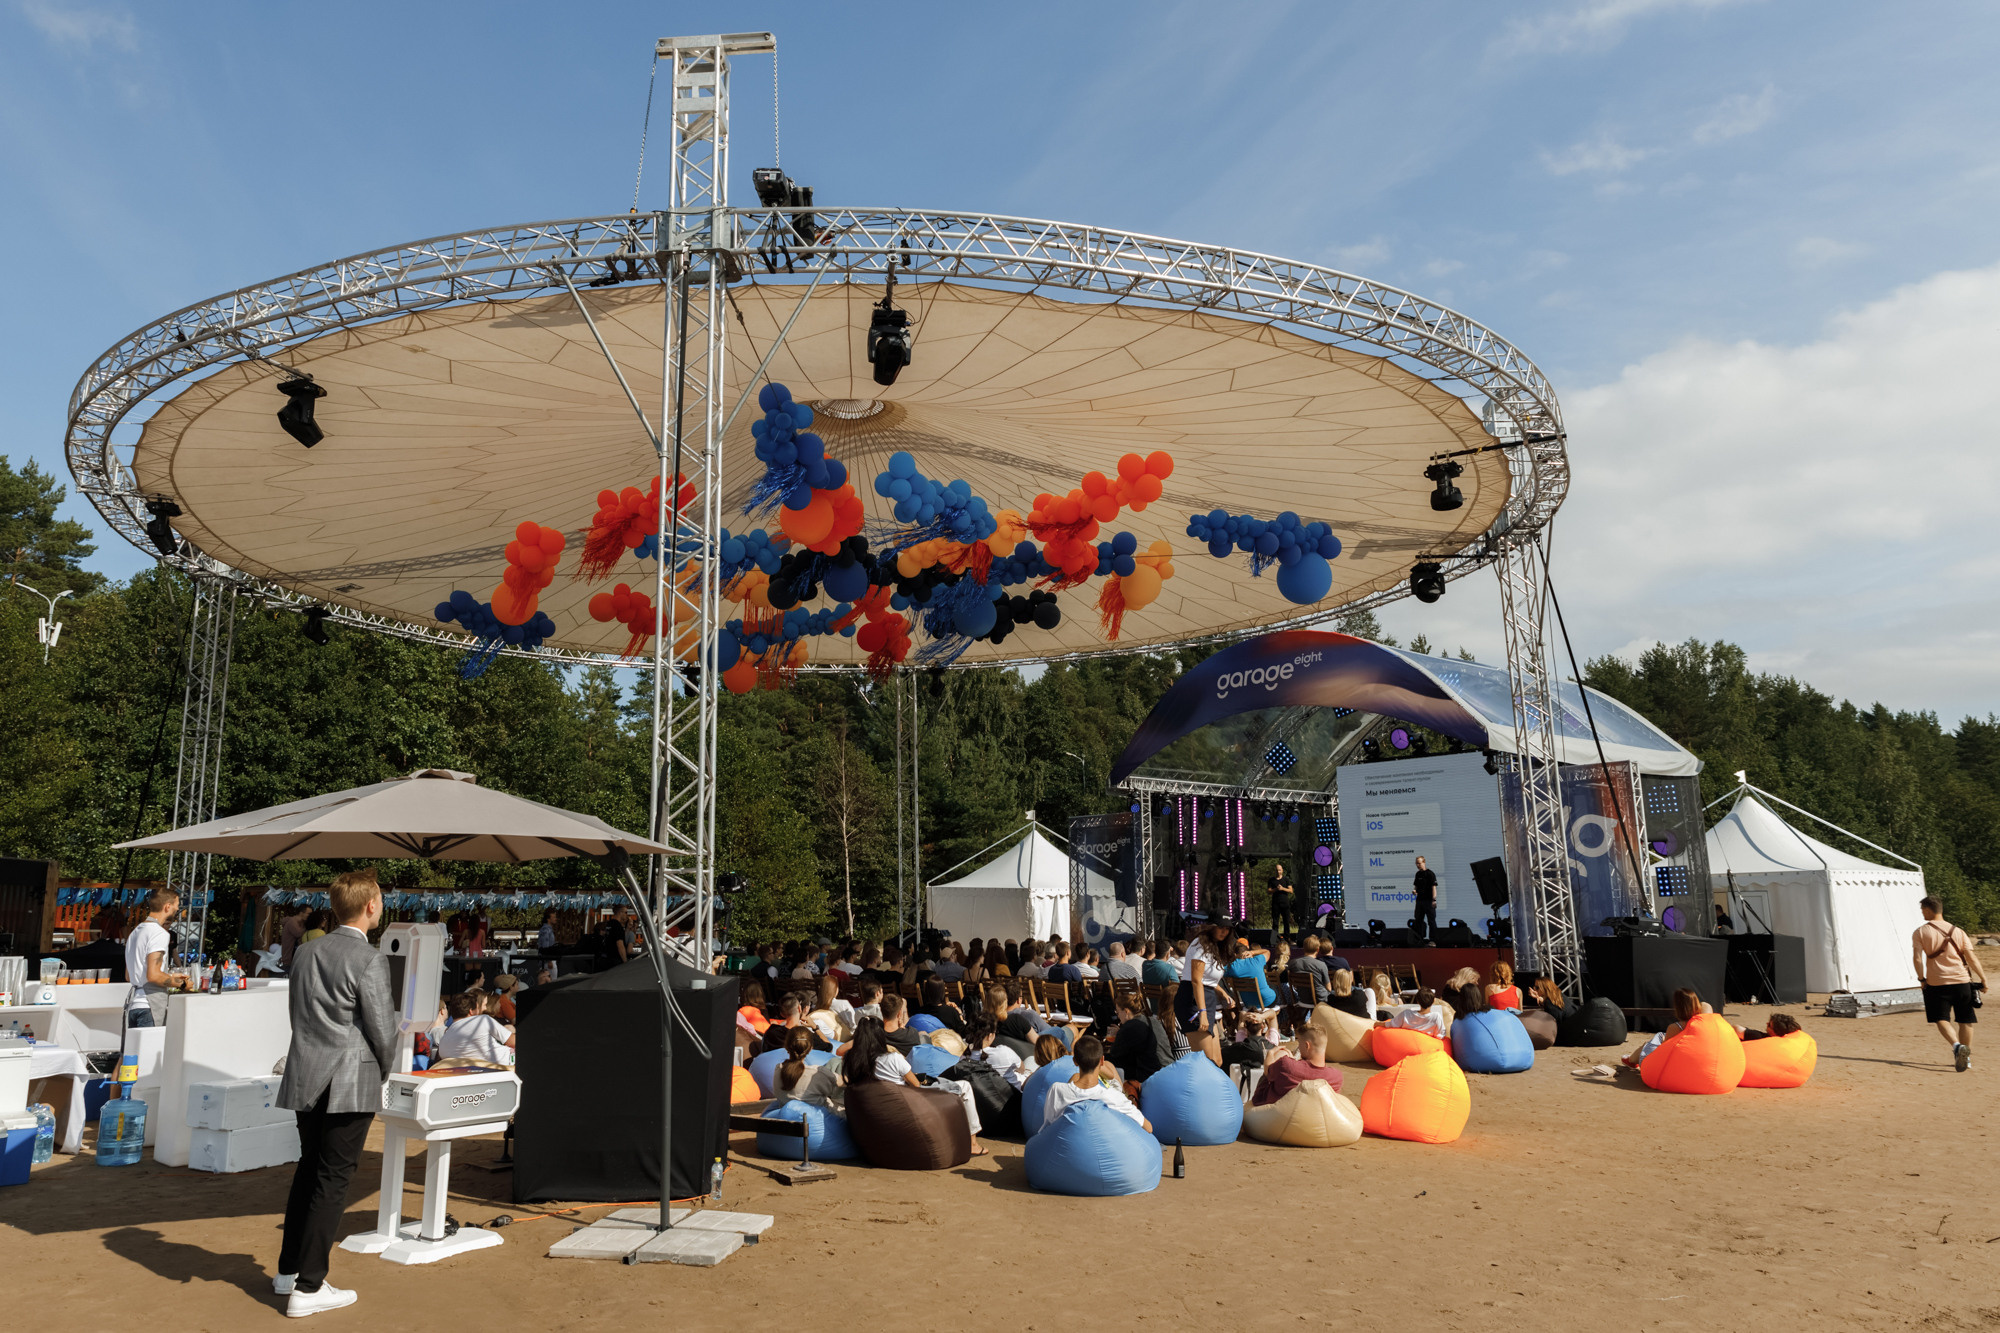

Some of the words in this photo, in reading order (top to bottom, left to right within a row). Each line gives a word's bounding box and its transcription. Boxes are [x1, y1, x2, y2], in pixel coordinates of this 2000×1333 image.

[1217, 662, 1294, 699] garage
[1294, 651, 1322, 667] eight
[1365, 789, 1378, 797] Мы
[1379, 787, 1416, 796] меняемся
[1366, 821, 1383, 831] iOS
[1079, 841, 1118, 859] garage
[1369, 858, 1384, 867] ML
[1371, 891, 1417, 903] Платфор
[452, 1091, 486, 1108] garage
